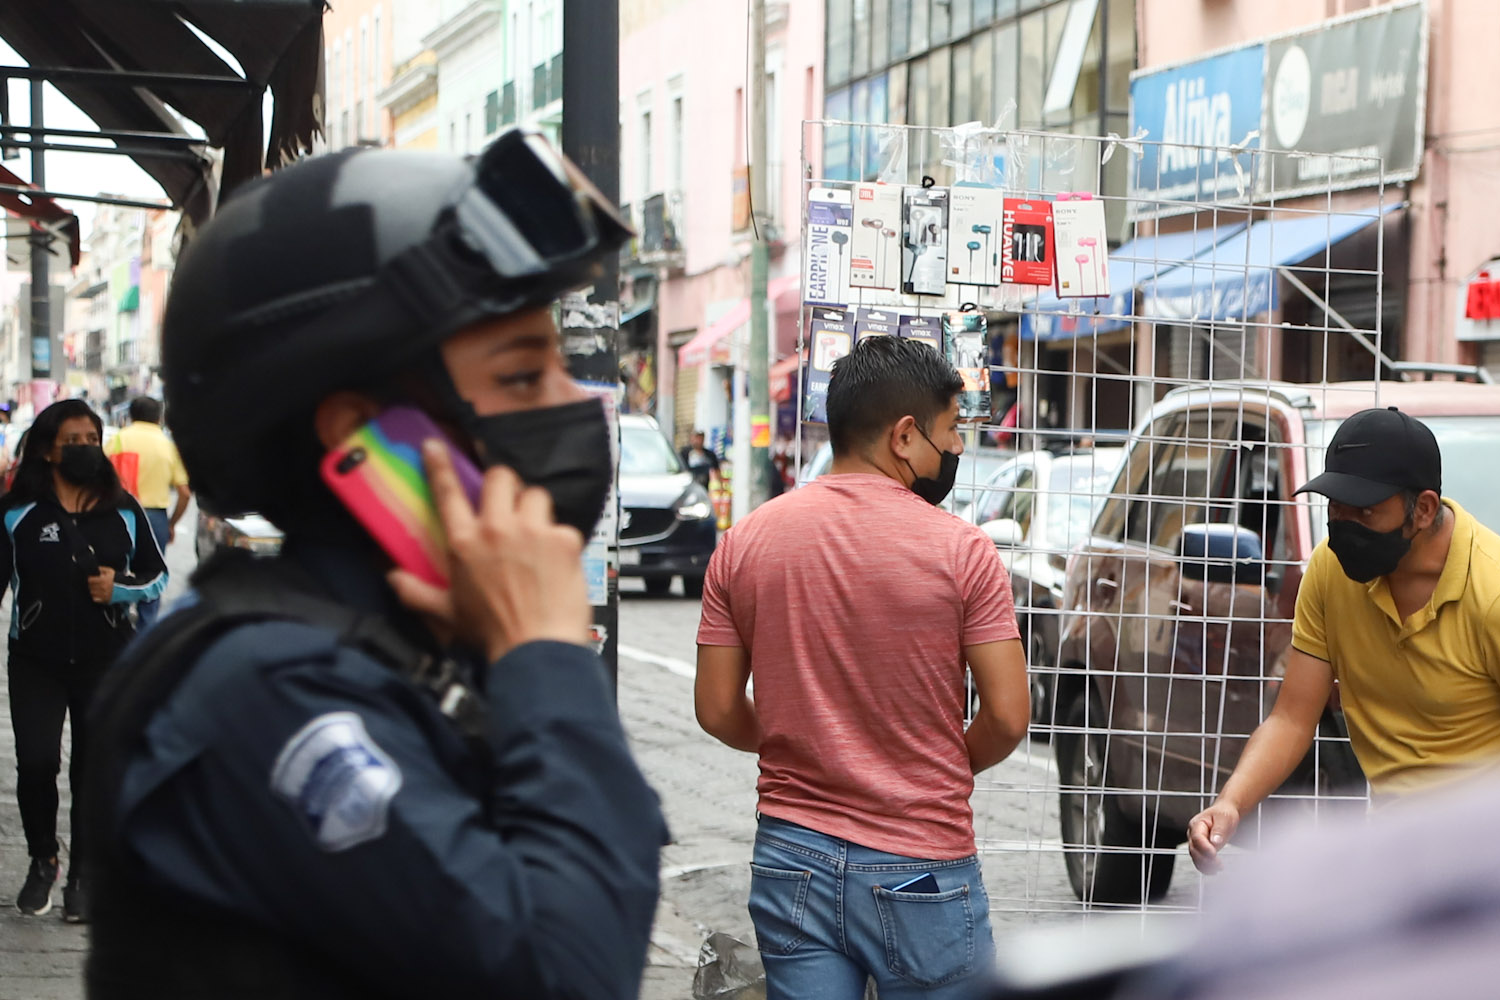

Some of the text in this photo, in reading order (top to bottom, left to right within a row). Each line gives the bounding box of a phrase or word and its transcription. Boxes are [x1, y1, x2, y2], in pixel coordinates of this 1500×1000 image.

[809, 226, 829, 299] EARPHONE
[1003, 210, 1016, 283] HUAWEI
[811, 382, 829, 393] EARP
